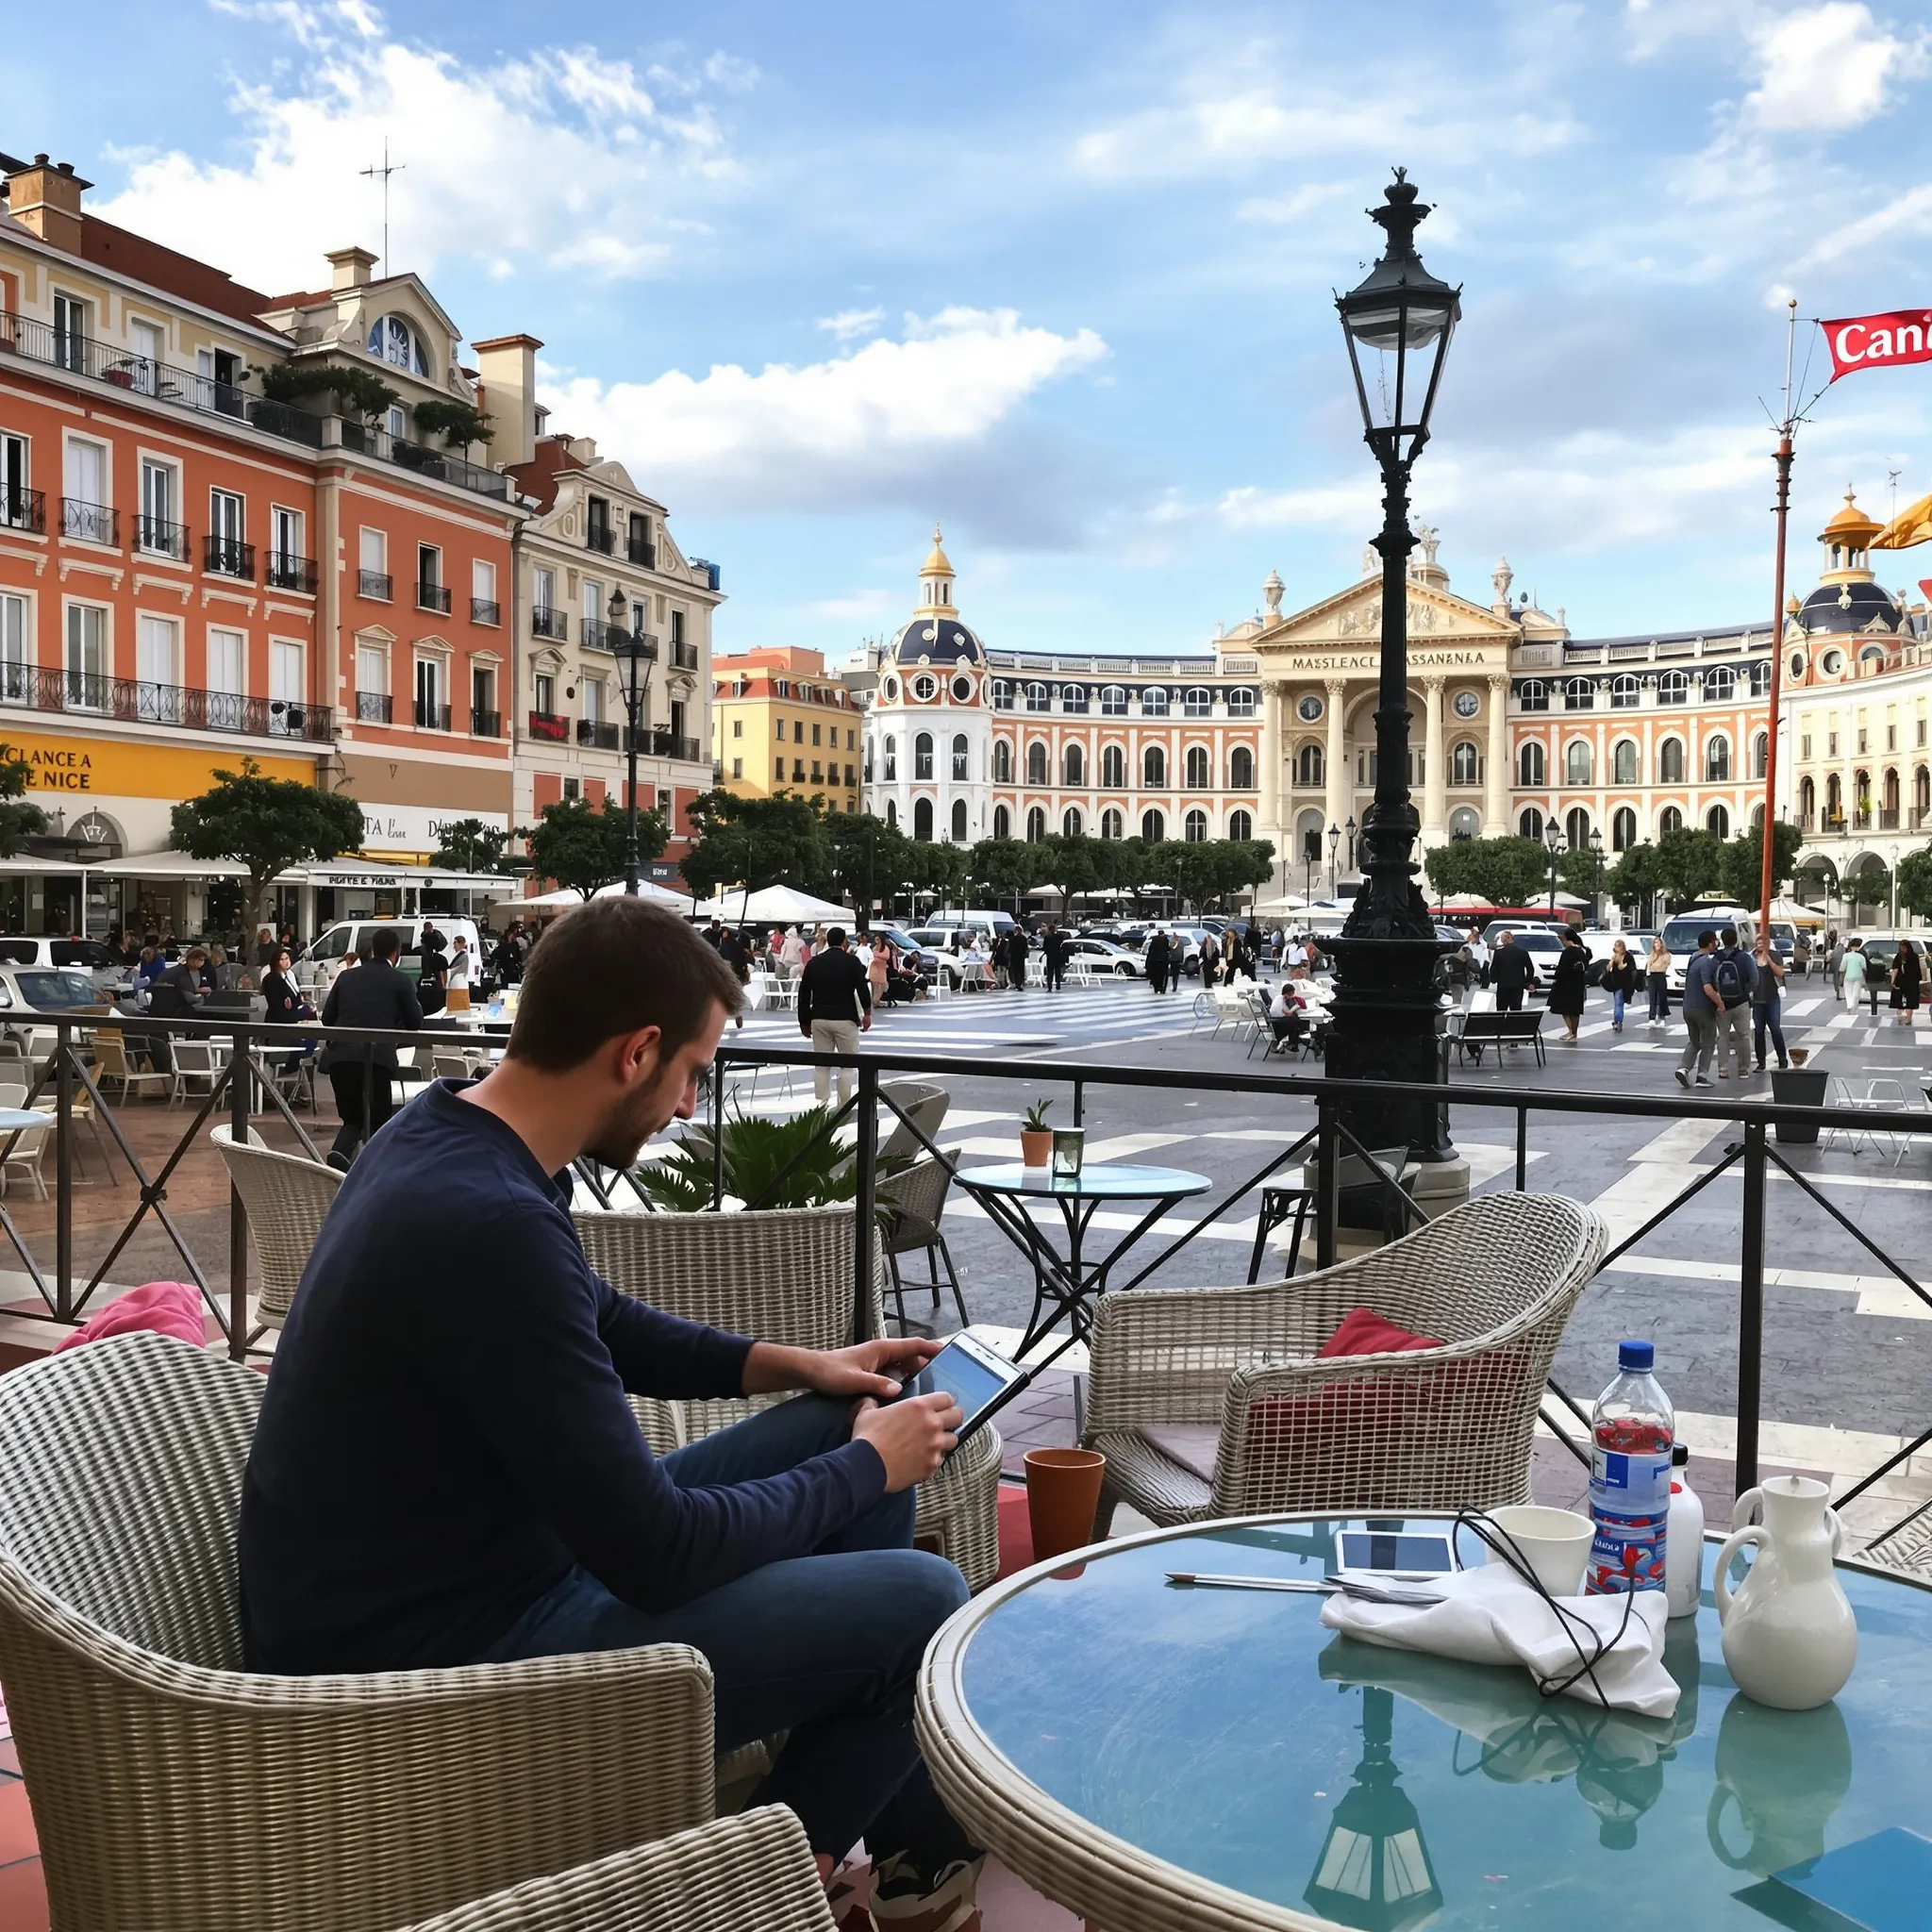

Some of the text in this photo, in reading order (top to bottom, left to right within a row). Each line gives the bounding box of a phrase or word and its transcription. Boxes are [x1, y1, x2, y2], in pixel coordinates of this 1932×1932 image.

[1836, 324, 1932, 363] Can
[80, 754, 92, 769] A
[43, 770, 91, 790] NICE
